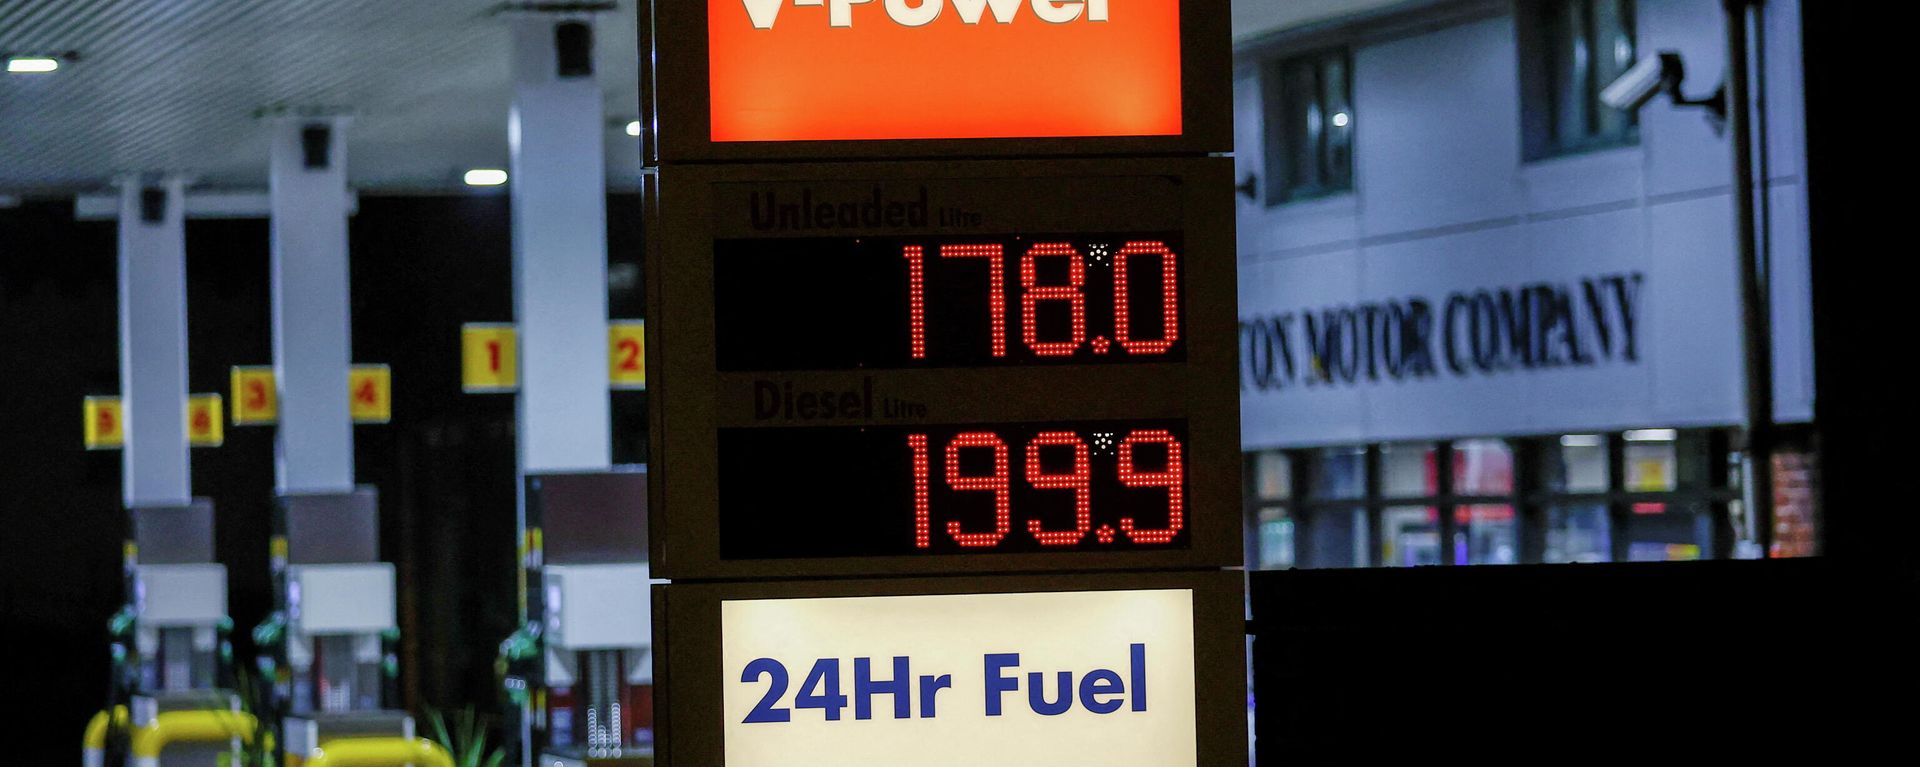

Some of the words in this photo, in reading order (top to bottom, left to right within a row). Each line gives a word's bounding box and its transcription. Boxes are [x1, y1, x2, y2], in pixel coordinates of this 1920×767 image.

[749, 184, 929, 231] Unleaded
[938, 207, 983, 228] Litre
[903, 241, 1179, 359] 178.0
[1302, 298, 1437, 387] MOTOR
[1443, 272, 1643, 376] COMPANY
[485, 339, 502, 373] 1
[616, 337, 642, 372] 2
[752, 375, 873, 421] Diesel
[882, 396, 928, 418] Litre
[907, 429, 1184, 549] 199.9
[740, 655, 952, 724] 24Hr
[983, 643, 1148, 717] Fuel
